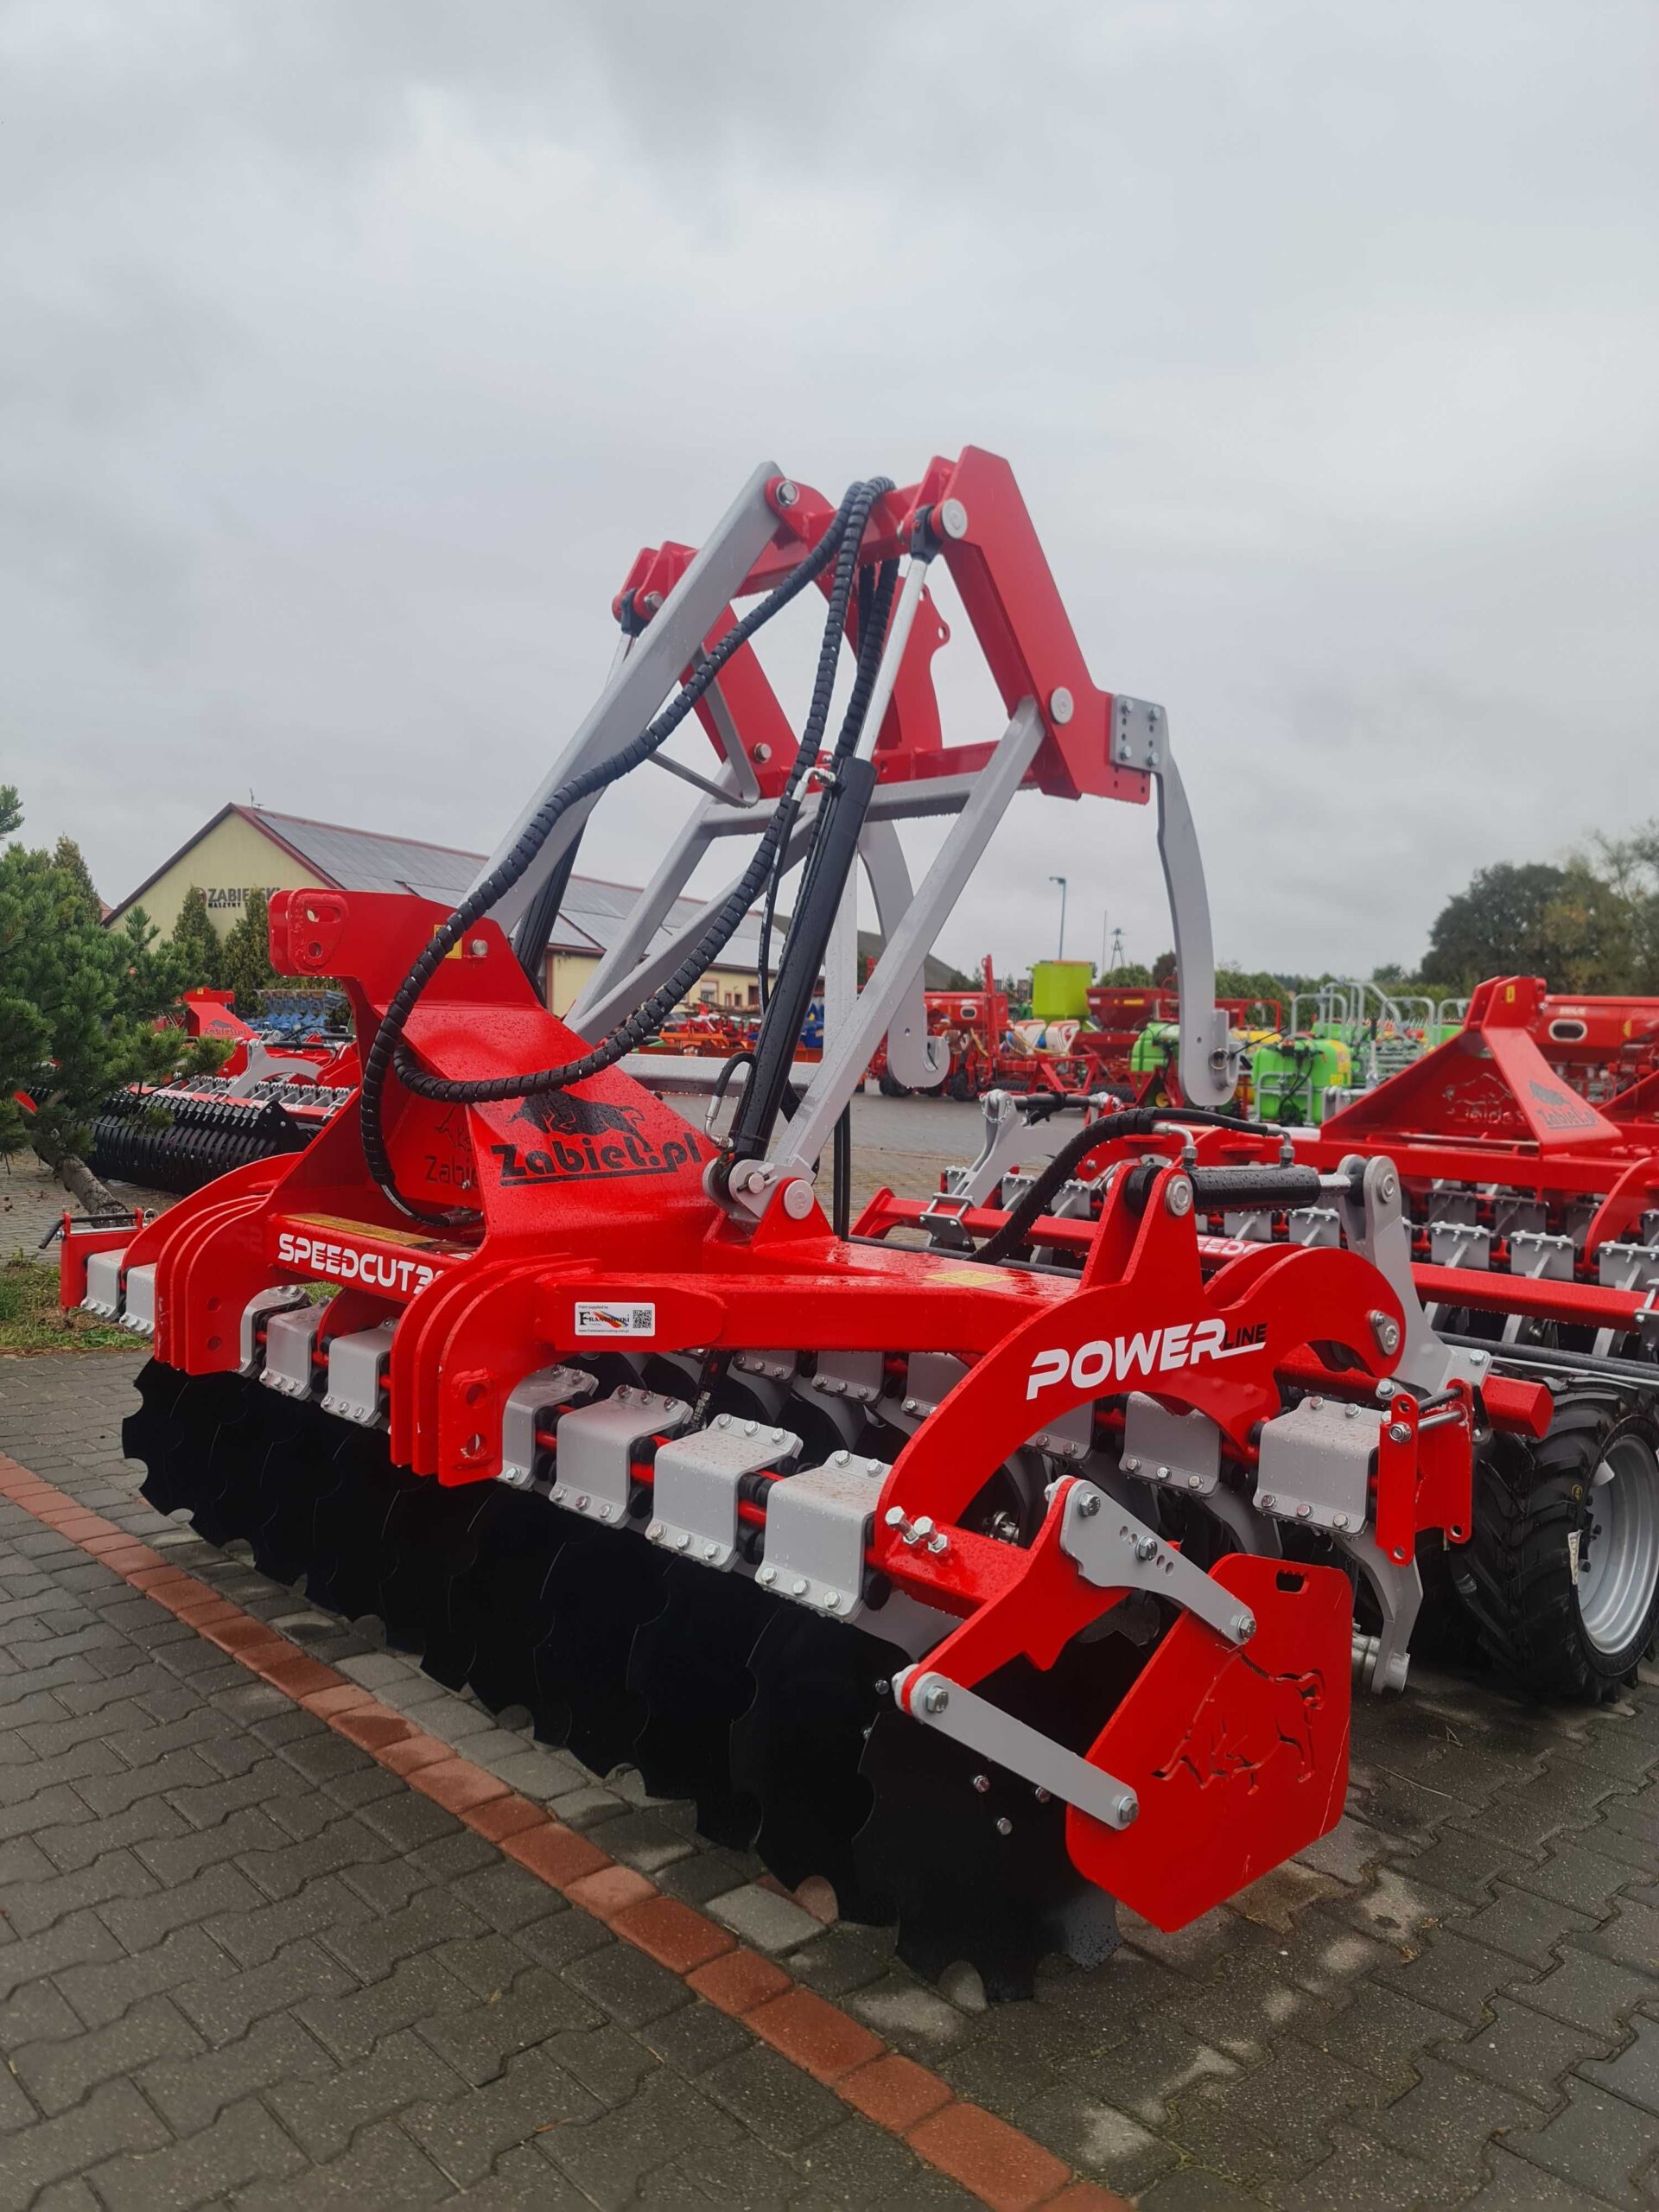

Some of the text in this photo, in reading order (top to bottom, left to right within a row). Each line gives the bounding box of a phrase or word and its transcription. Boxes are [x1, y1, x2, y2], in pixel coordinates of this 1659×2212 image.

[490, 1132, 702, 1179] Zabiel.pl
[1026, 1318, 1268, 1401] POWER LINE
